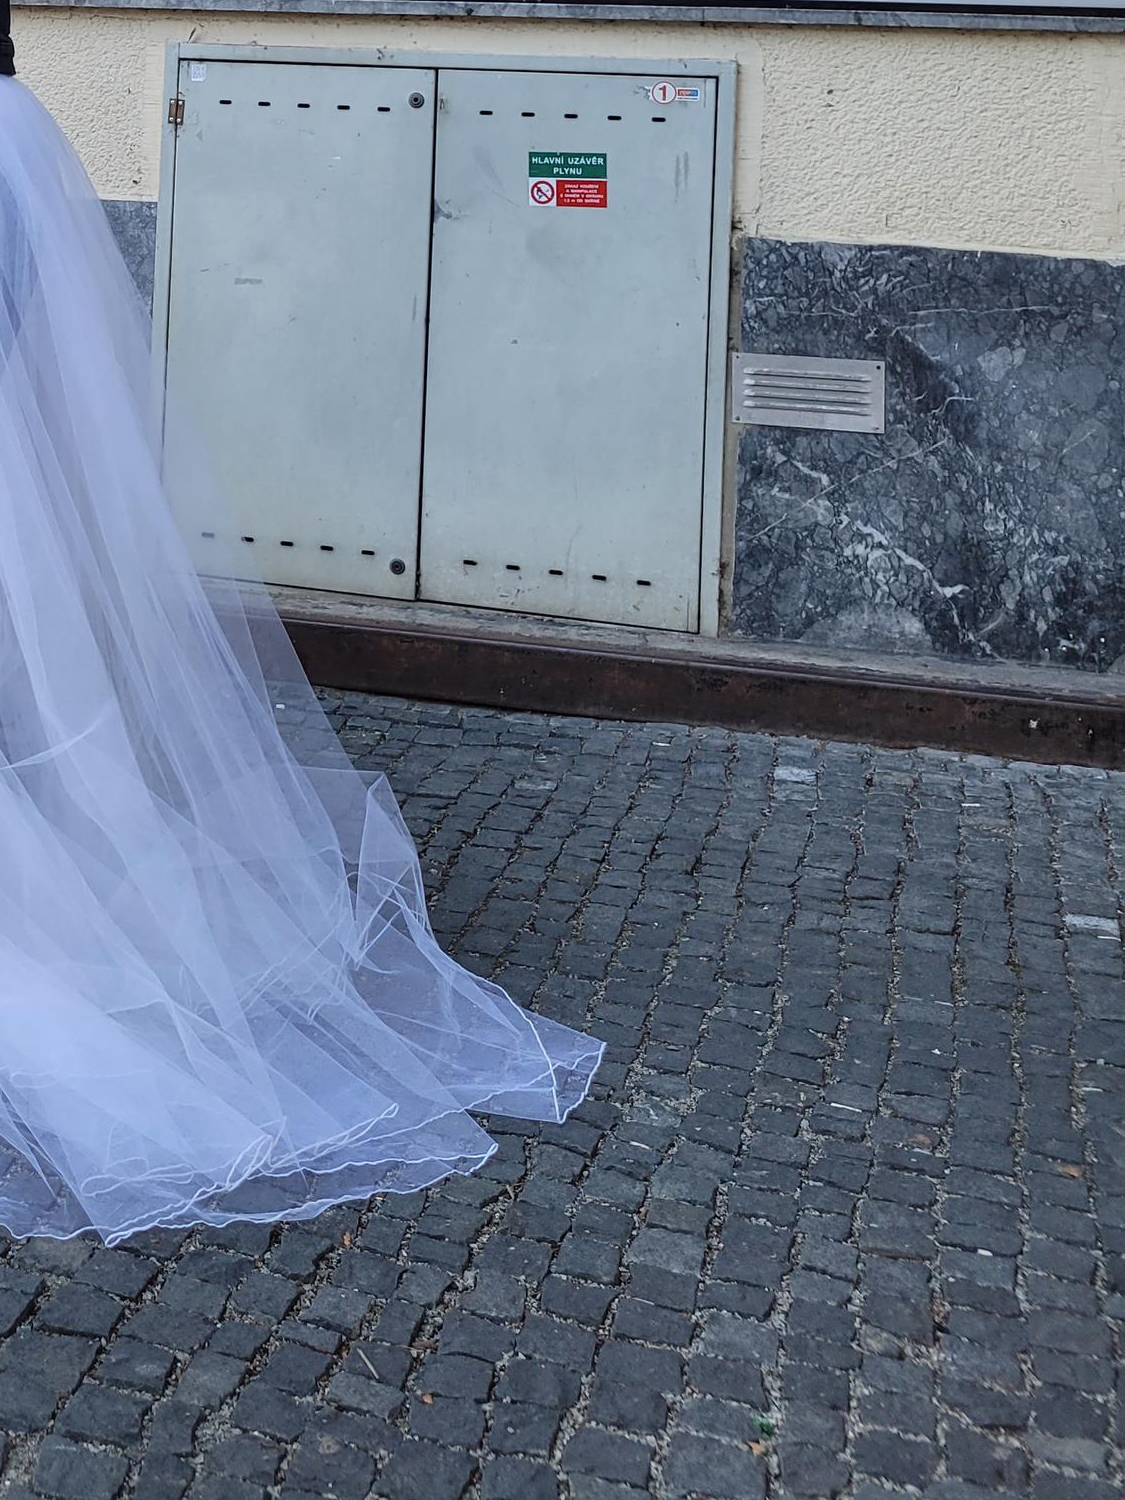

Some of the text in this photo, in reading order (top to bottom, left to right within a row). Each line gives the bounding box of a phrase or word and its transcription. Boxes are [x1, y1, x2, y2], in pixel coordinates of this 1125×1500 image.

[658, 85, 667, 101] 1
[531, 156, 564, 164] HLAVNÍ
[553, 167, 583, 175] PLYNU
